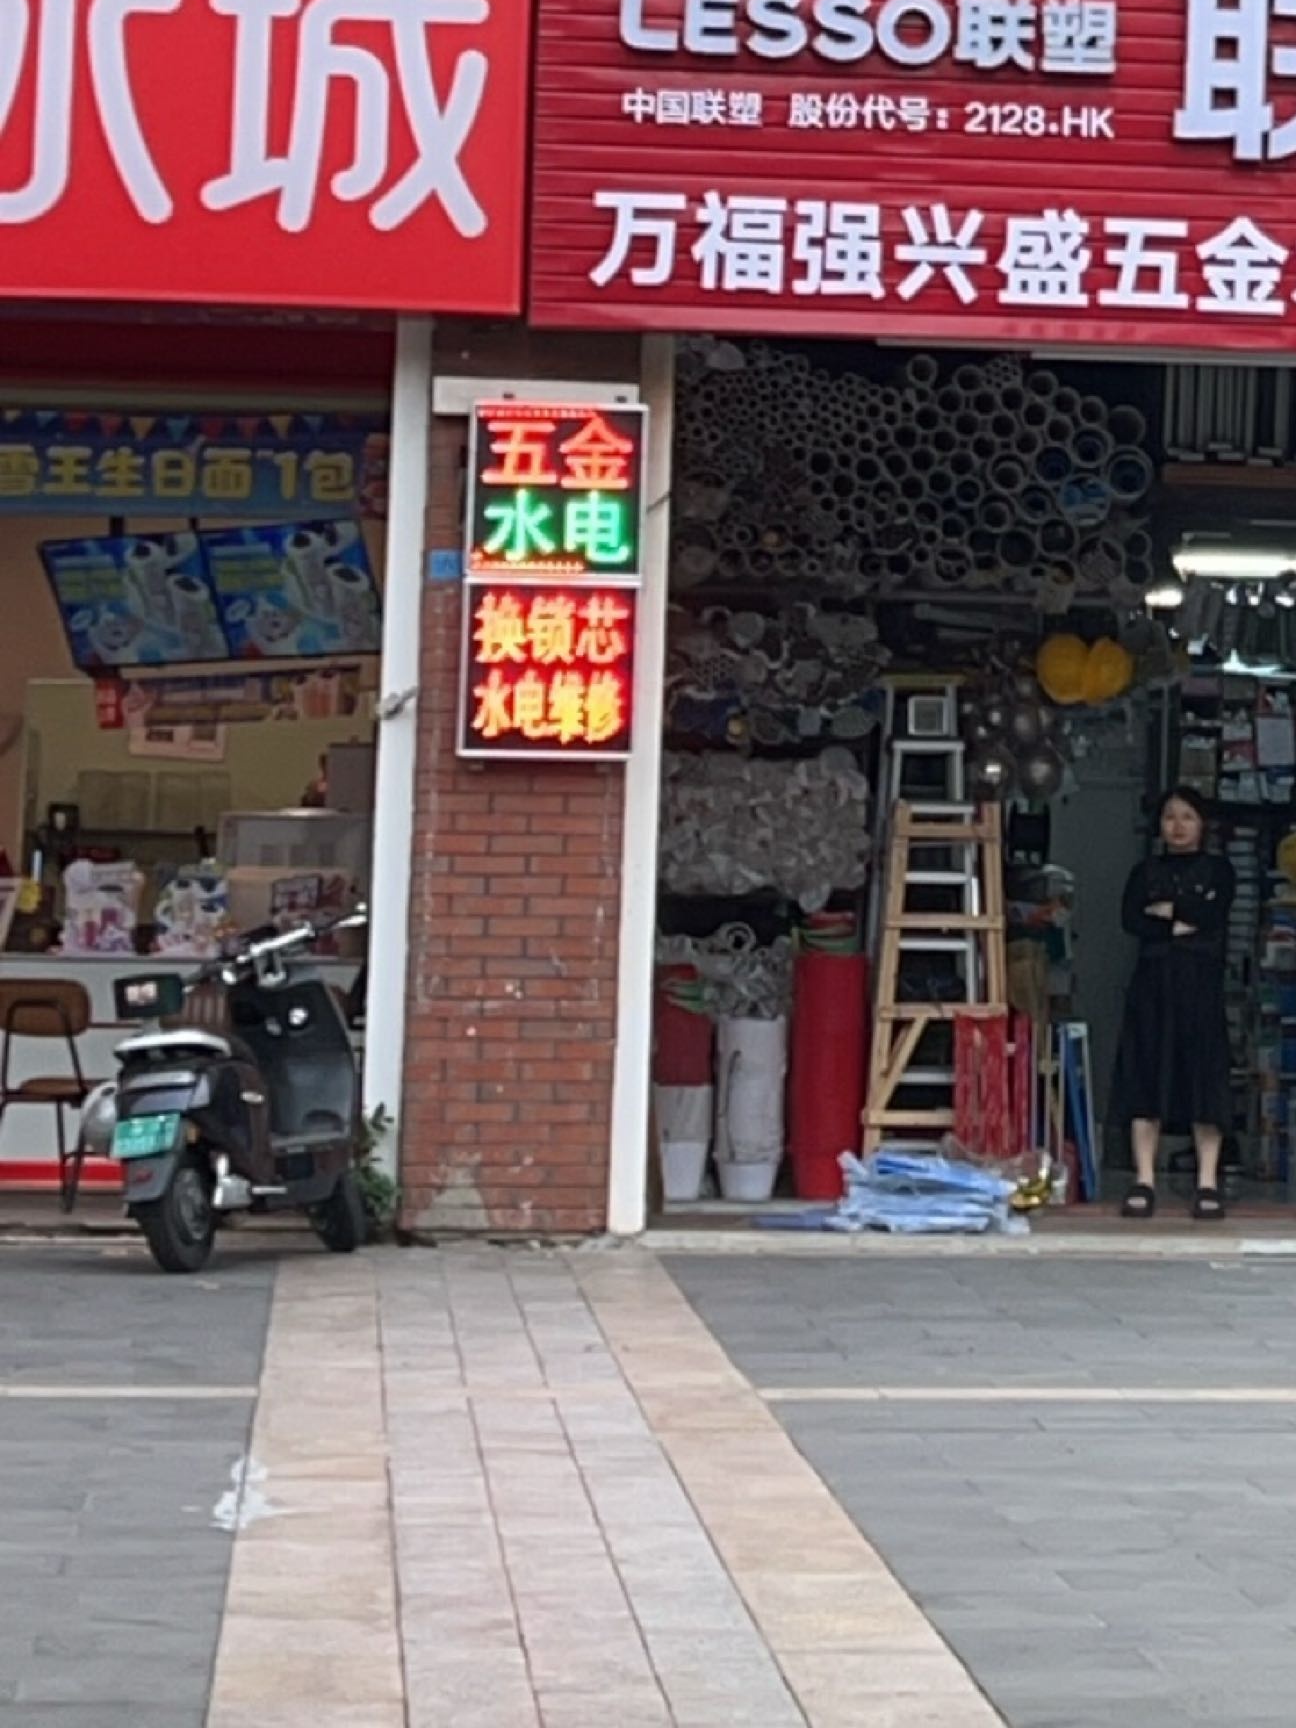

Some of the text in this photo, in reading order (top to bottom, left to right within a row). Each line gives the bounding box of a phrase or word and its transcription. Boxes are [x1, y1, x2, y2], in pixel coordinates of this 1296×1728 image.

[621, 89, 763, 127] 中国联塑
[480, 415, 634, 489] 五金
[483, 488, 631, 562] 水电
[474, 591, 630, 664] 换锁芯
[472, 669, 624, 744] 水电维修
